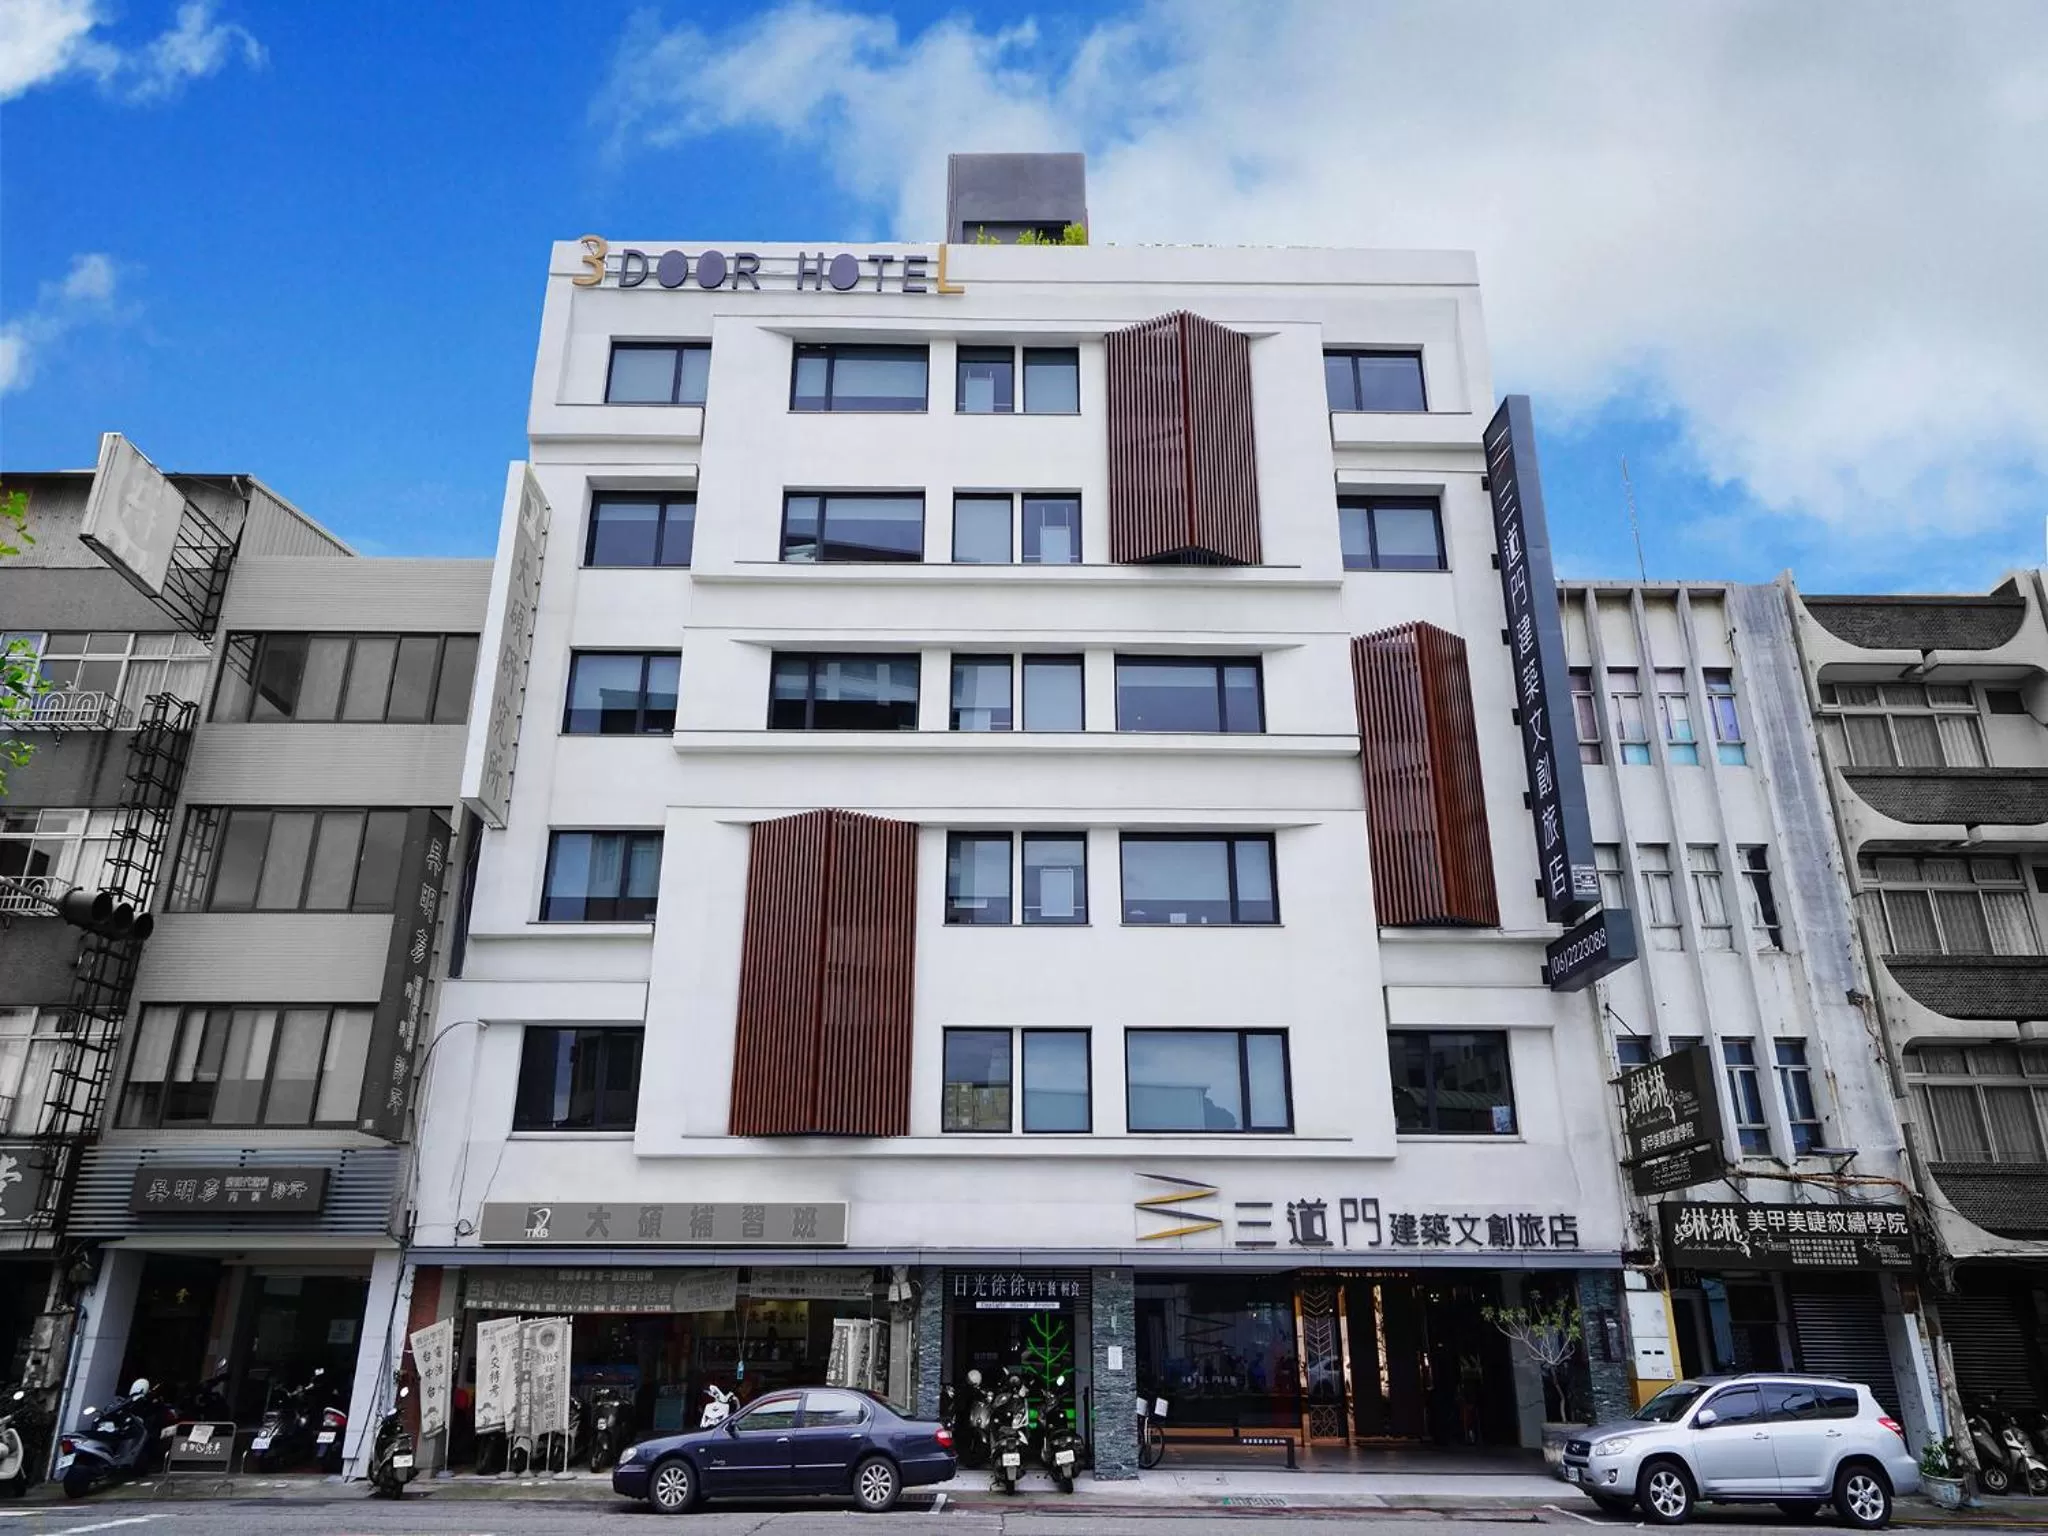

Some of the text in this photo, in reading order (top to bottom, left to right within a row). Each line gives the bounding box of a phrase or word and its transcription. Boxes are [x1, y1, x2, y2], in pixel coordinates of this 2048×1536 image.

[572, 234, 966, 294] 3 DOOR HOTEL
[1550, 927, 1607, 981] (06)2223088
[524, 1227, 550, 1239] TKB
[584, 1204, 819, 1240] 大碩補習班
